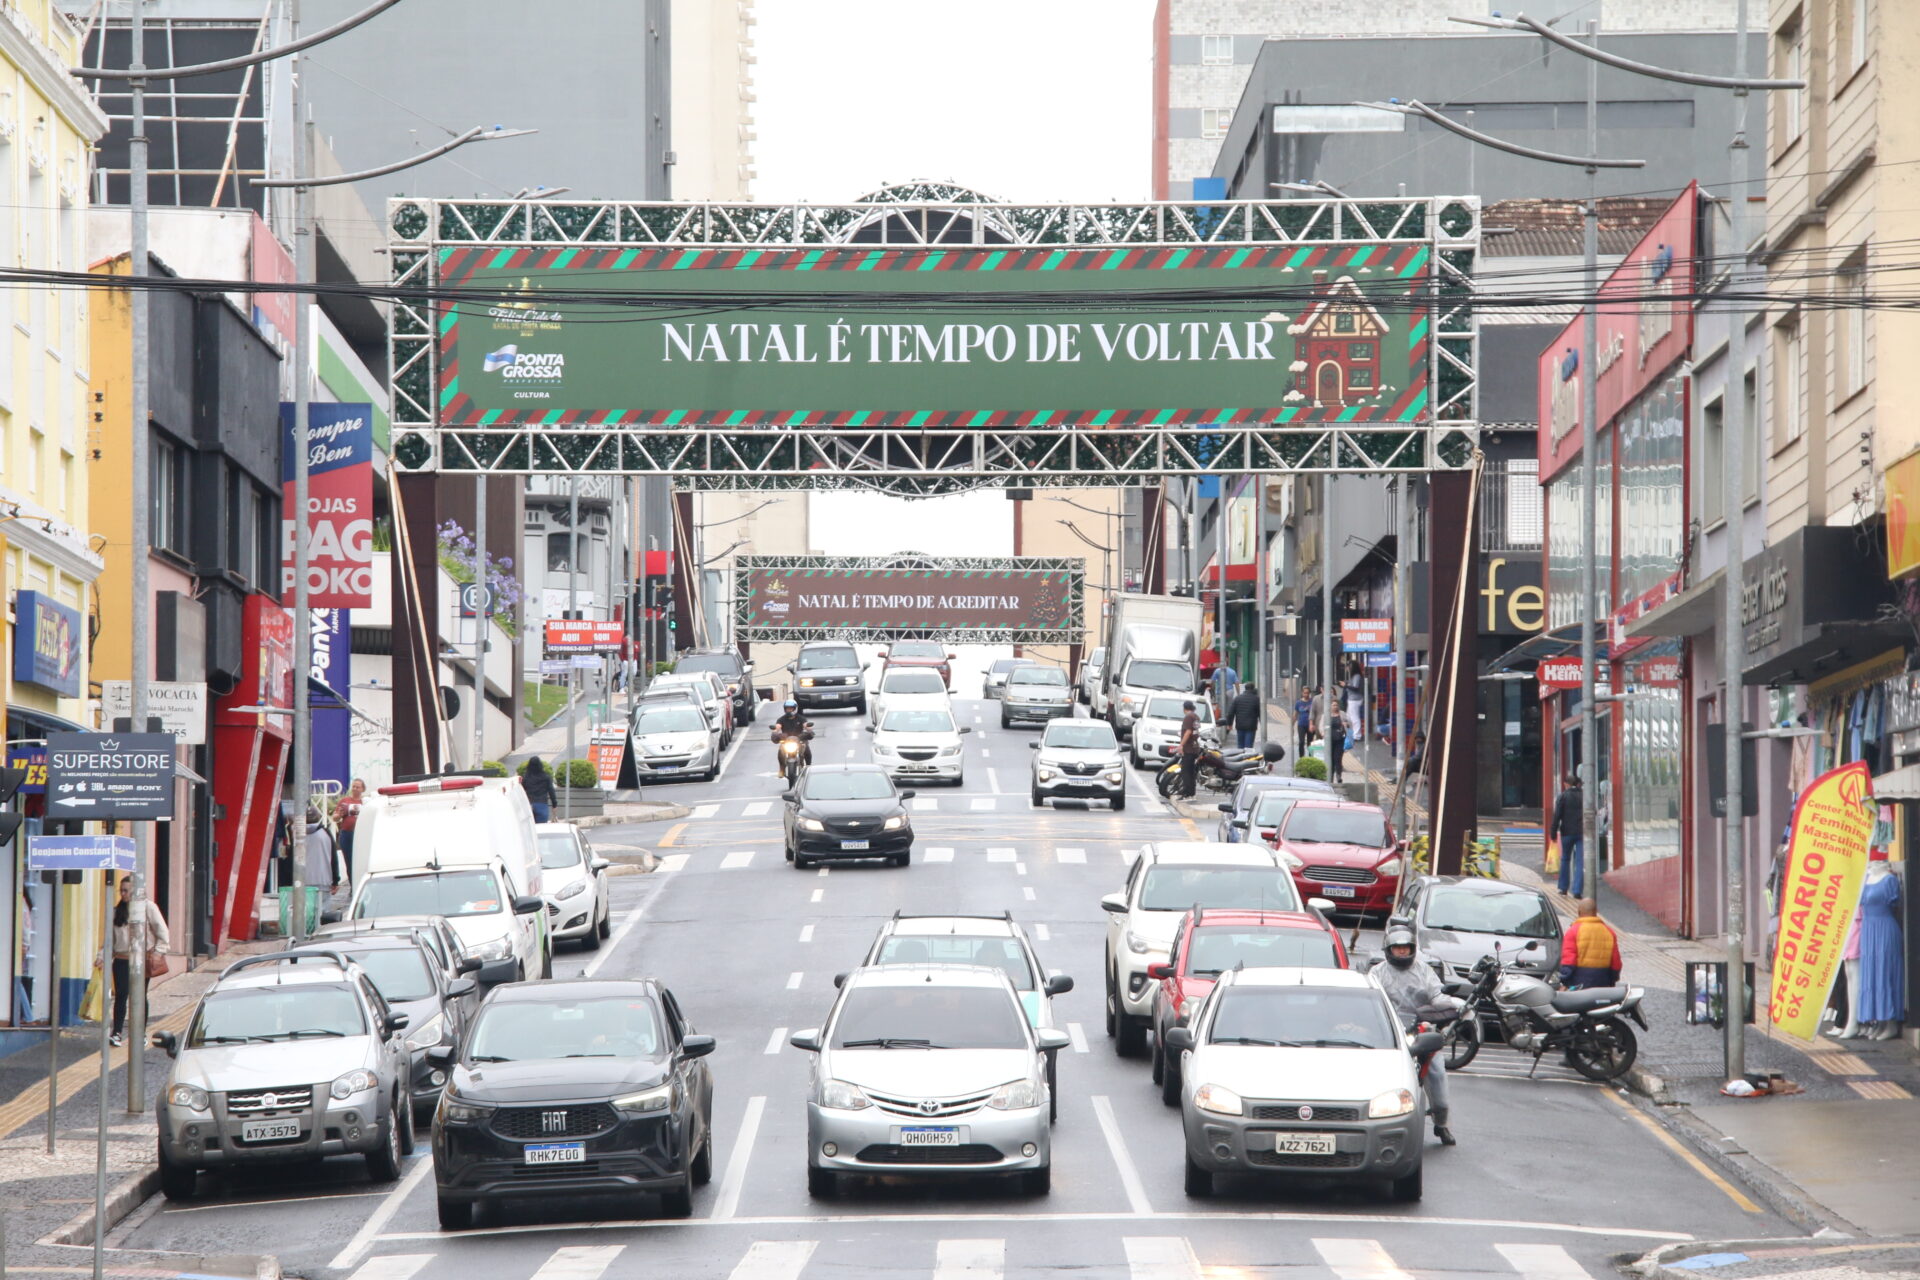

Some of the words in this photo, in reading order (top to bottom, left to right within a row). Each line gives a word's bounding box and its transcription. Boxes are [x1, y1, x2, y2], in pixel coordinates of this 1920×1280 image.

[662, 323, 818, 362] NATAL
[827, 317, 851, 363] É
[861, 323, 1017, 363] TEMPO
[1025, 323, 1081, 362] DE
[1091, 321, 1276, 361] VOLTAR
[515, 354, 565, 366] PONTA
[502, 365, 562, 378] GROSSA
[291, 416, 364, 442] ompre
[308, 443, 354, 467] Bem
[307, 498, 357, 513] OJAS
[798, 594, 849, 608] NATAL
[852, 592, 860, 608] É
[862, 594, 914, 608] TEMPO
[916, 594, 935, 608] DE
[938, 594, 1020, 609] ACREDITAR
[549, 621, 565, 630] SUA
[565, 621, 593, 631] MARCA
[596, 622, 622, 631] MARCA
[1343, 620, 1360, 630] SUA
[1360, 620, 1389, 630] MARCA
[561, 633, 581, 643] AQUI
[1356, 632, 1376, 642] AQUI
[53, 754, 170, 769] SUPERSTORE
[12, 758, 48, 785] VES
[91, 783, 106, 791] JBL
[1807, 799, 1842, 814] Center
[1811, 812, 1868, 842] Feminina
[1803, 824, 1867, 854] Masculina
[32, 847, 72, 857] Benjamin
[73, 847, 110, 856] Constant
[1812, 838, 1853, 858] Infantil
[1771, 851, 1826, 1024] CREDIARIO
[1786, 992, 1805, 1019] 6X
[1803, 873, 1844, 966] ENTRADA
[1817, 961, 1832, 989] Todos
[1829, 948, 1838, 961] os
[542, 1111, 568, 1132] FIAT
